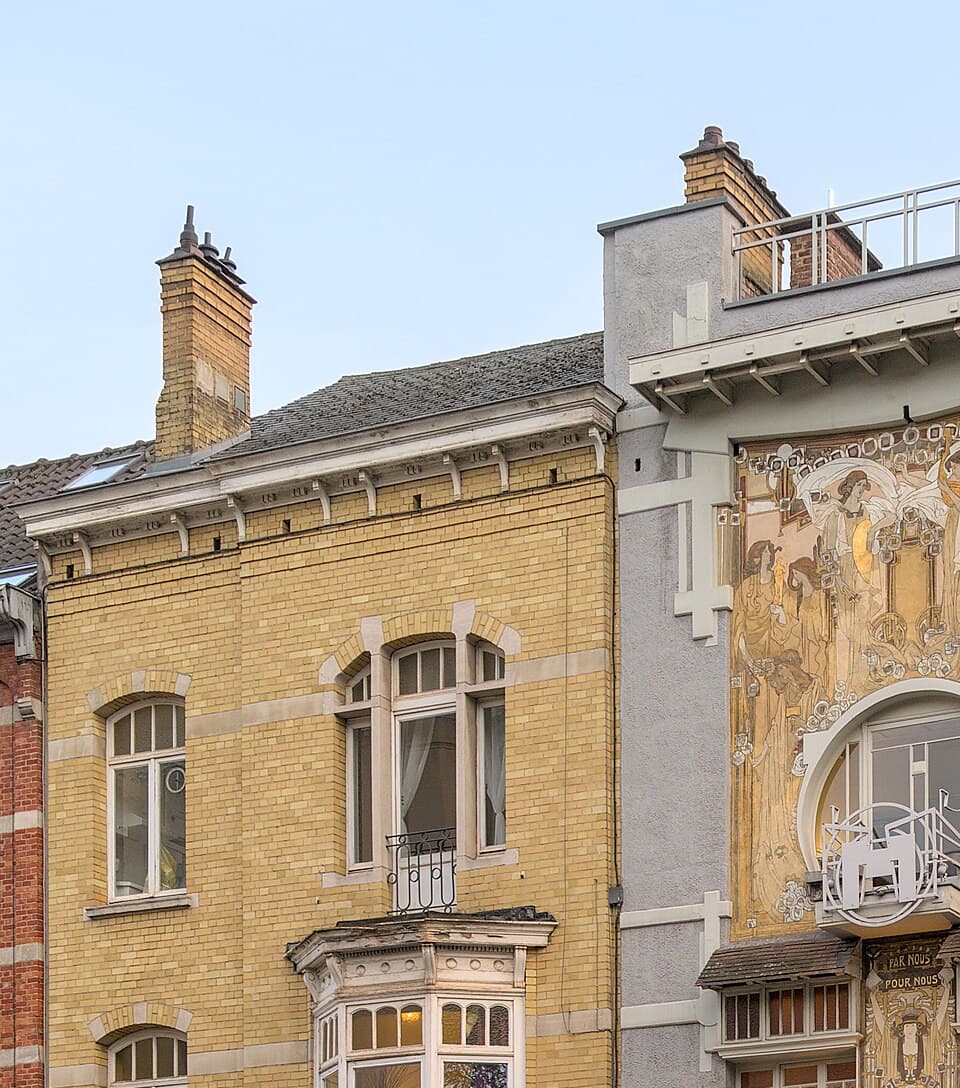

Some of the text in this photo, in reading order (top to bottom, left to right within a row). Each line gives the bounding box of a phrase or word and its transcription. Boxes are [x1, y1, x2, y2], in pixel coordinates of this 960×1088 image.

[889, 953, 931, 968] PAR NOUS
[885, 974, 938, 989] POUR NOUS
